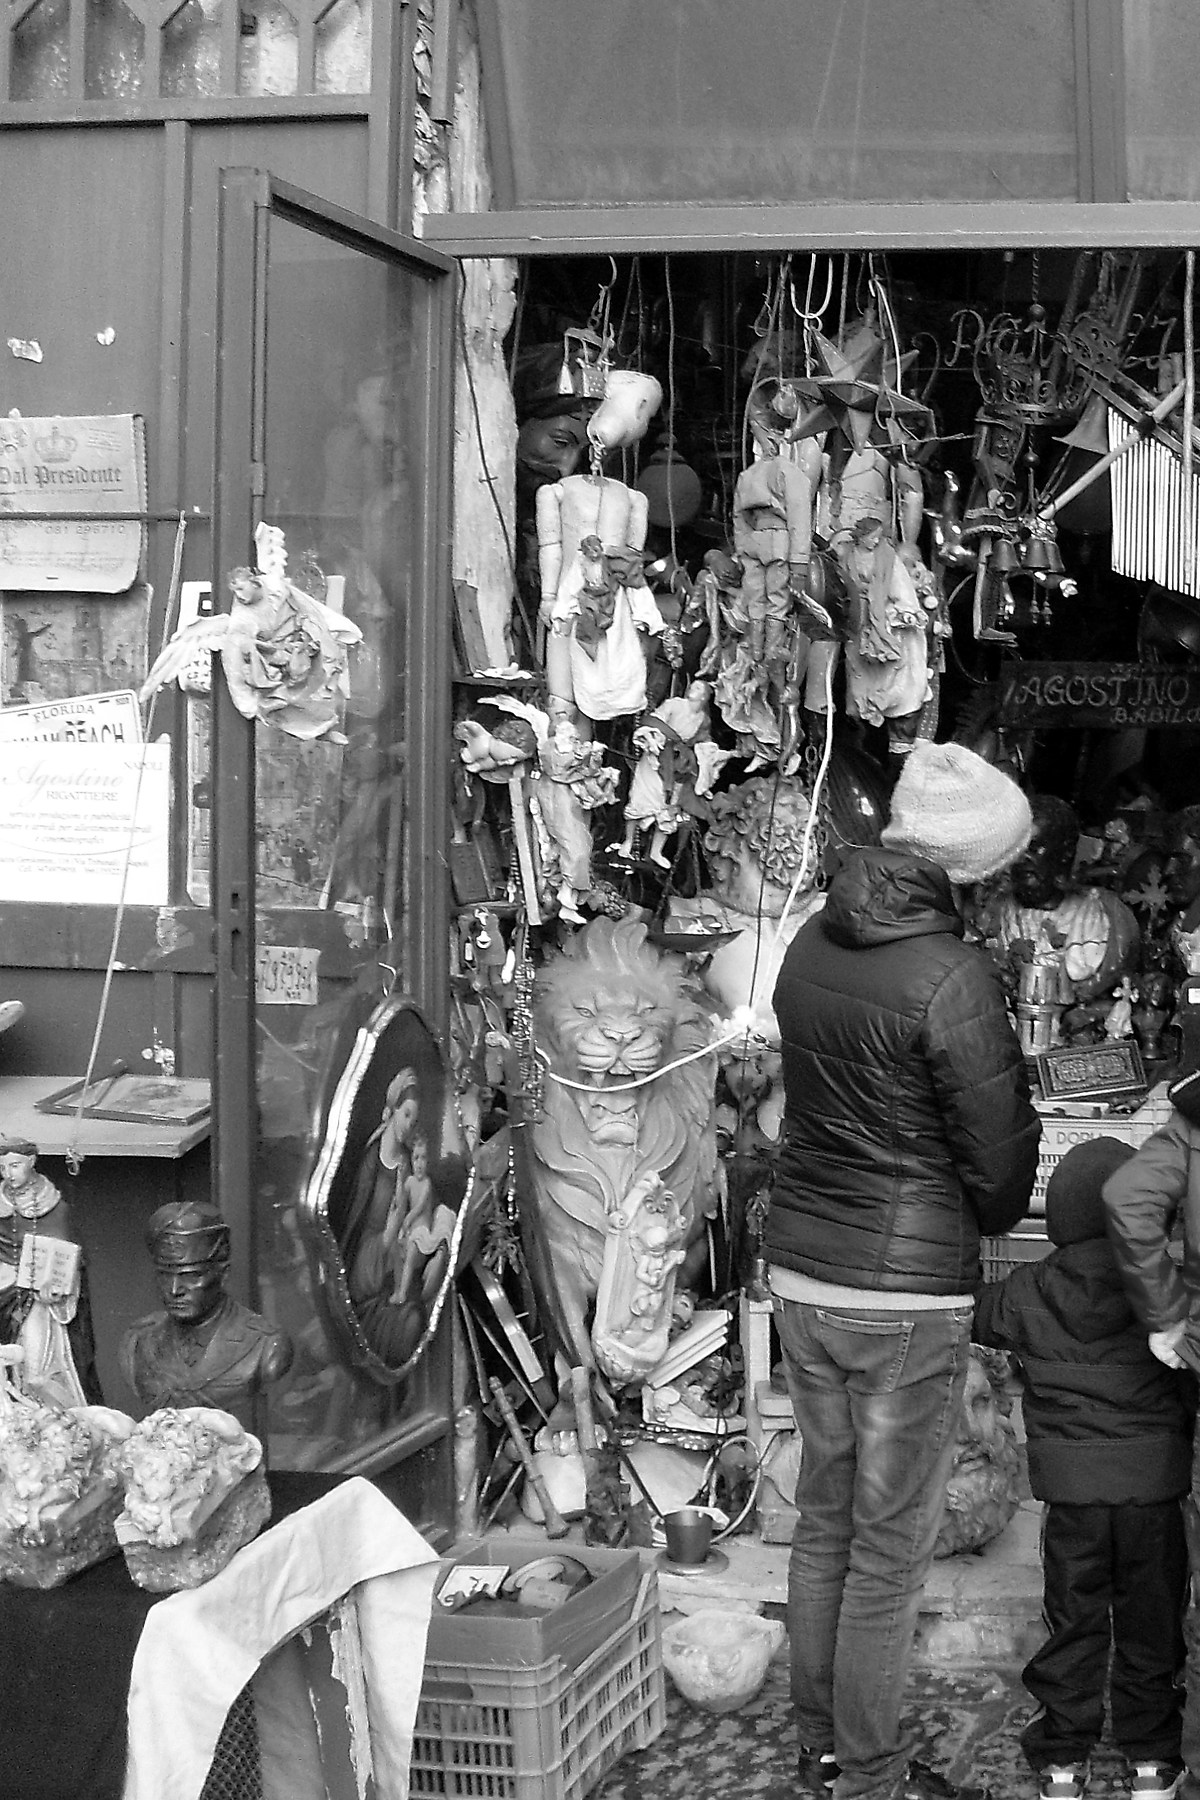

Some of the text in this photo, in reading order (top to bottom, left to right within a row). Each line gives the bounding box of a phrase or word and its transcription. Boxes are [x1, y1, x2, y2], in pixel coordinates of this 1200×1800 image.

[34, 465, 122, 488] Presidente
[1015, 674, 1190, 707] AGOSTINO
[33, 704, 95, 723] FLORIDA
[2, 759, 125, 808] Agostino
[46, 790, 119, 802] RIGATTIERE
